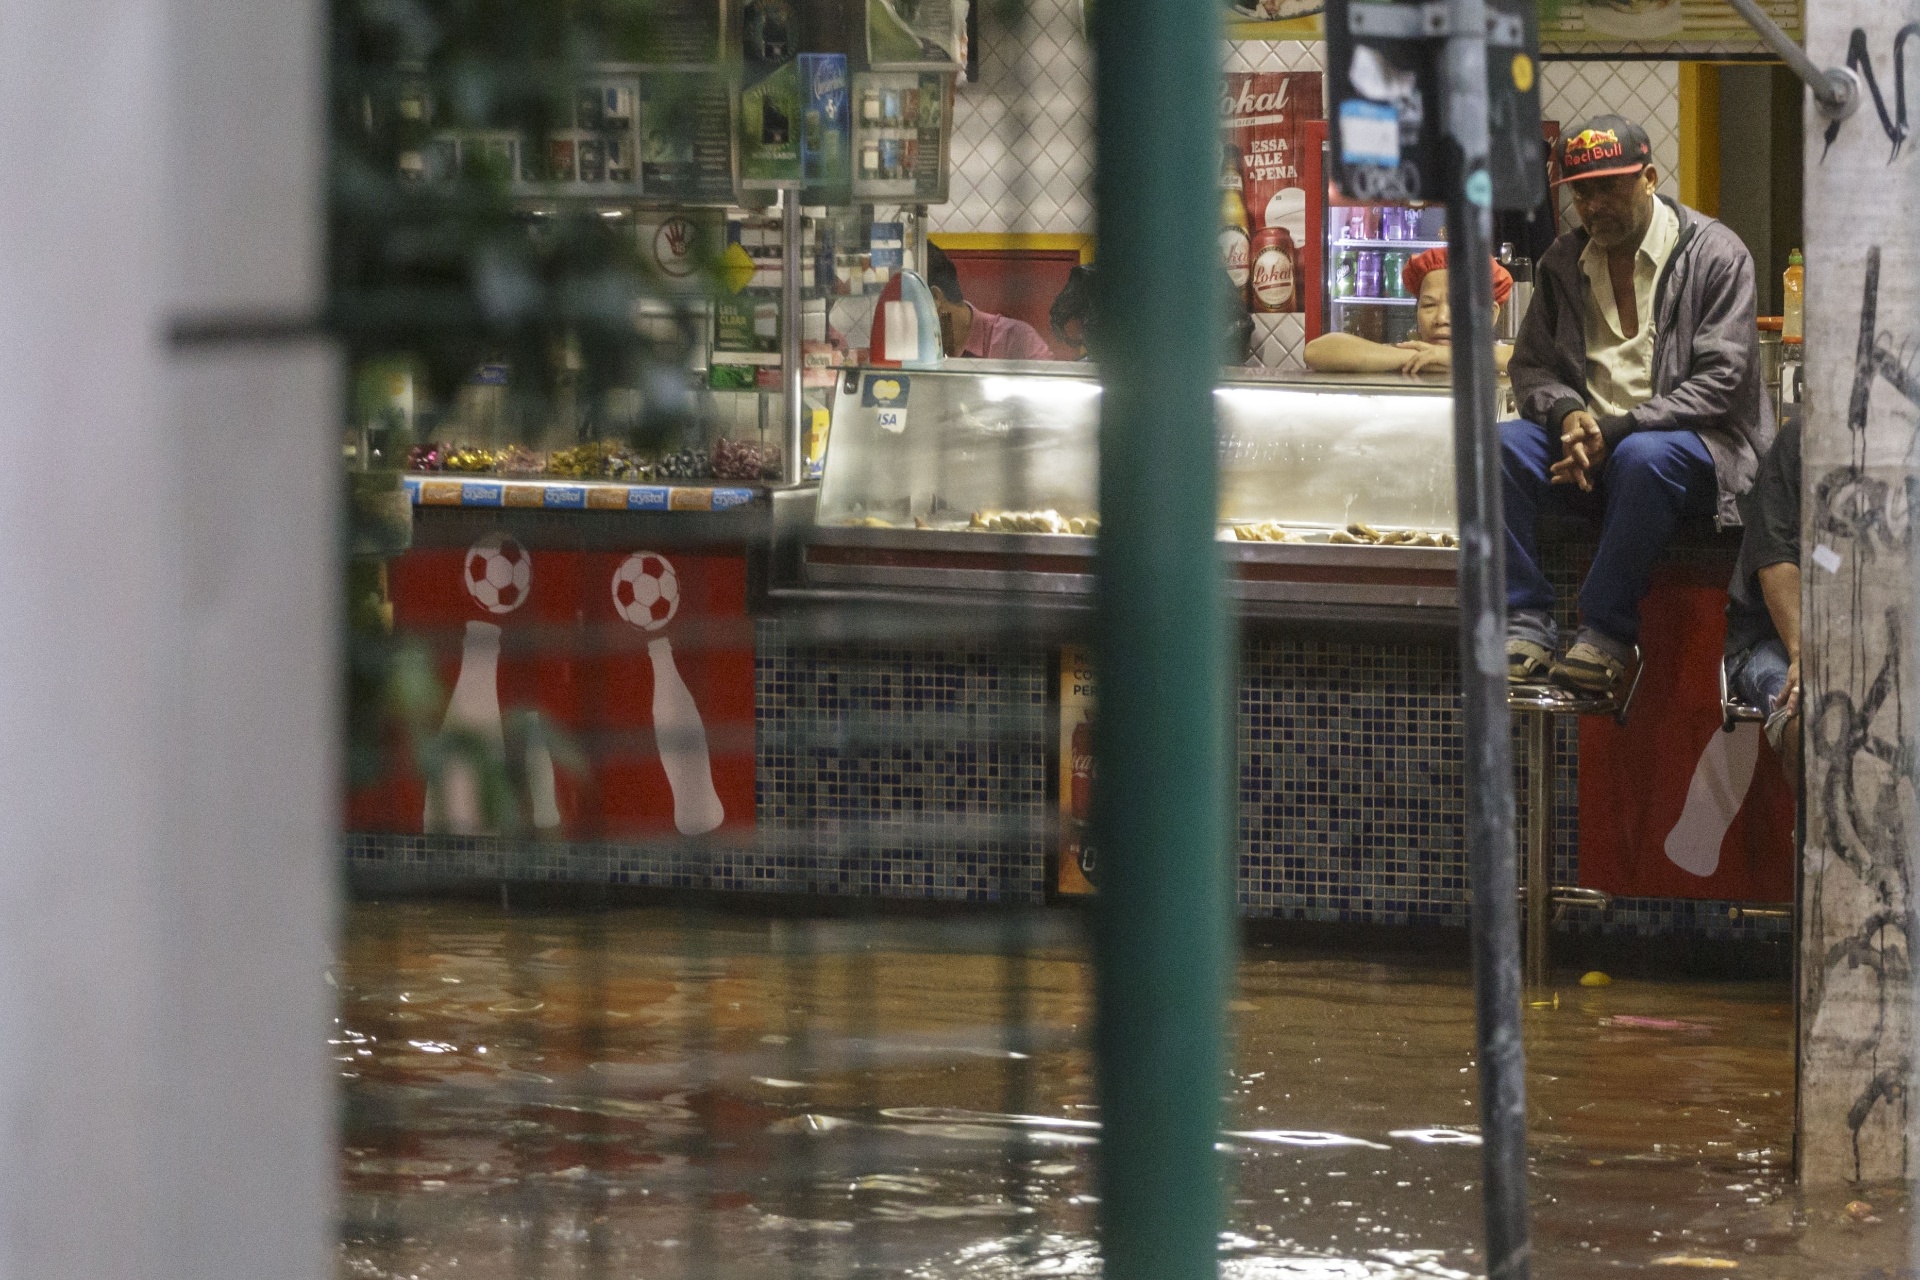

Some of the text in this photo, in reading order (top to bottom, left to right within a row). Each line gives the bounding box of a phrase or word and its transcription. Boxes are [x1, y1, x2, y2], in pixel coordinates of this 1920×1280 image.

[1251, 138, 1289, 154] ESSA
[1244, 152, 1283, 168] VALE
[1565, 142, 1623, 167] Red Bull
[1255, 165, 1299, 181] PENA
[1253, 264, 1292, 286] Lokal
[878, 413, 897, 426] ISA
[628, 492, 664, 506] crystal
[713, 493, 750, 507] crystal
